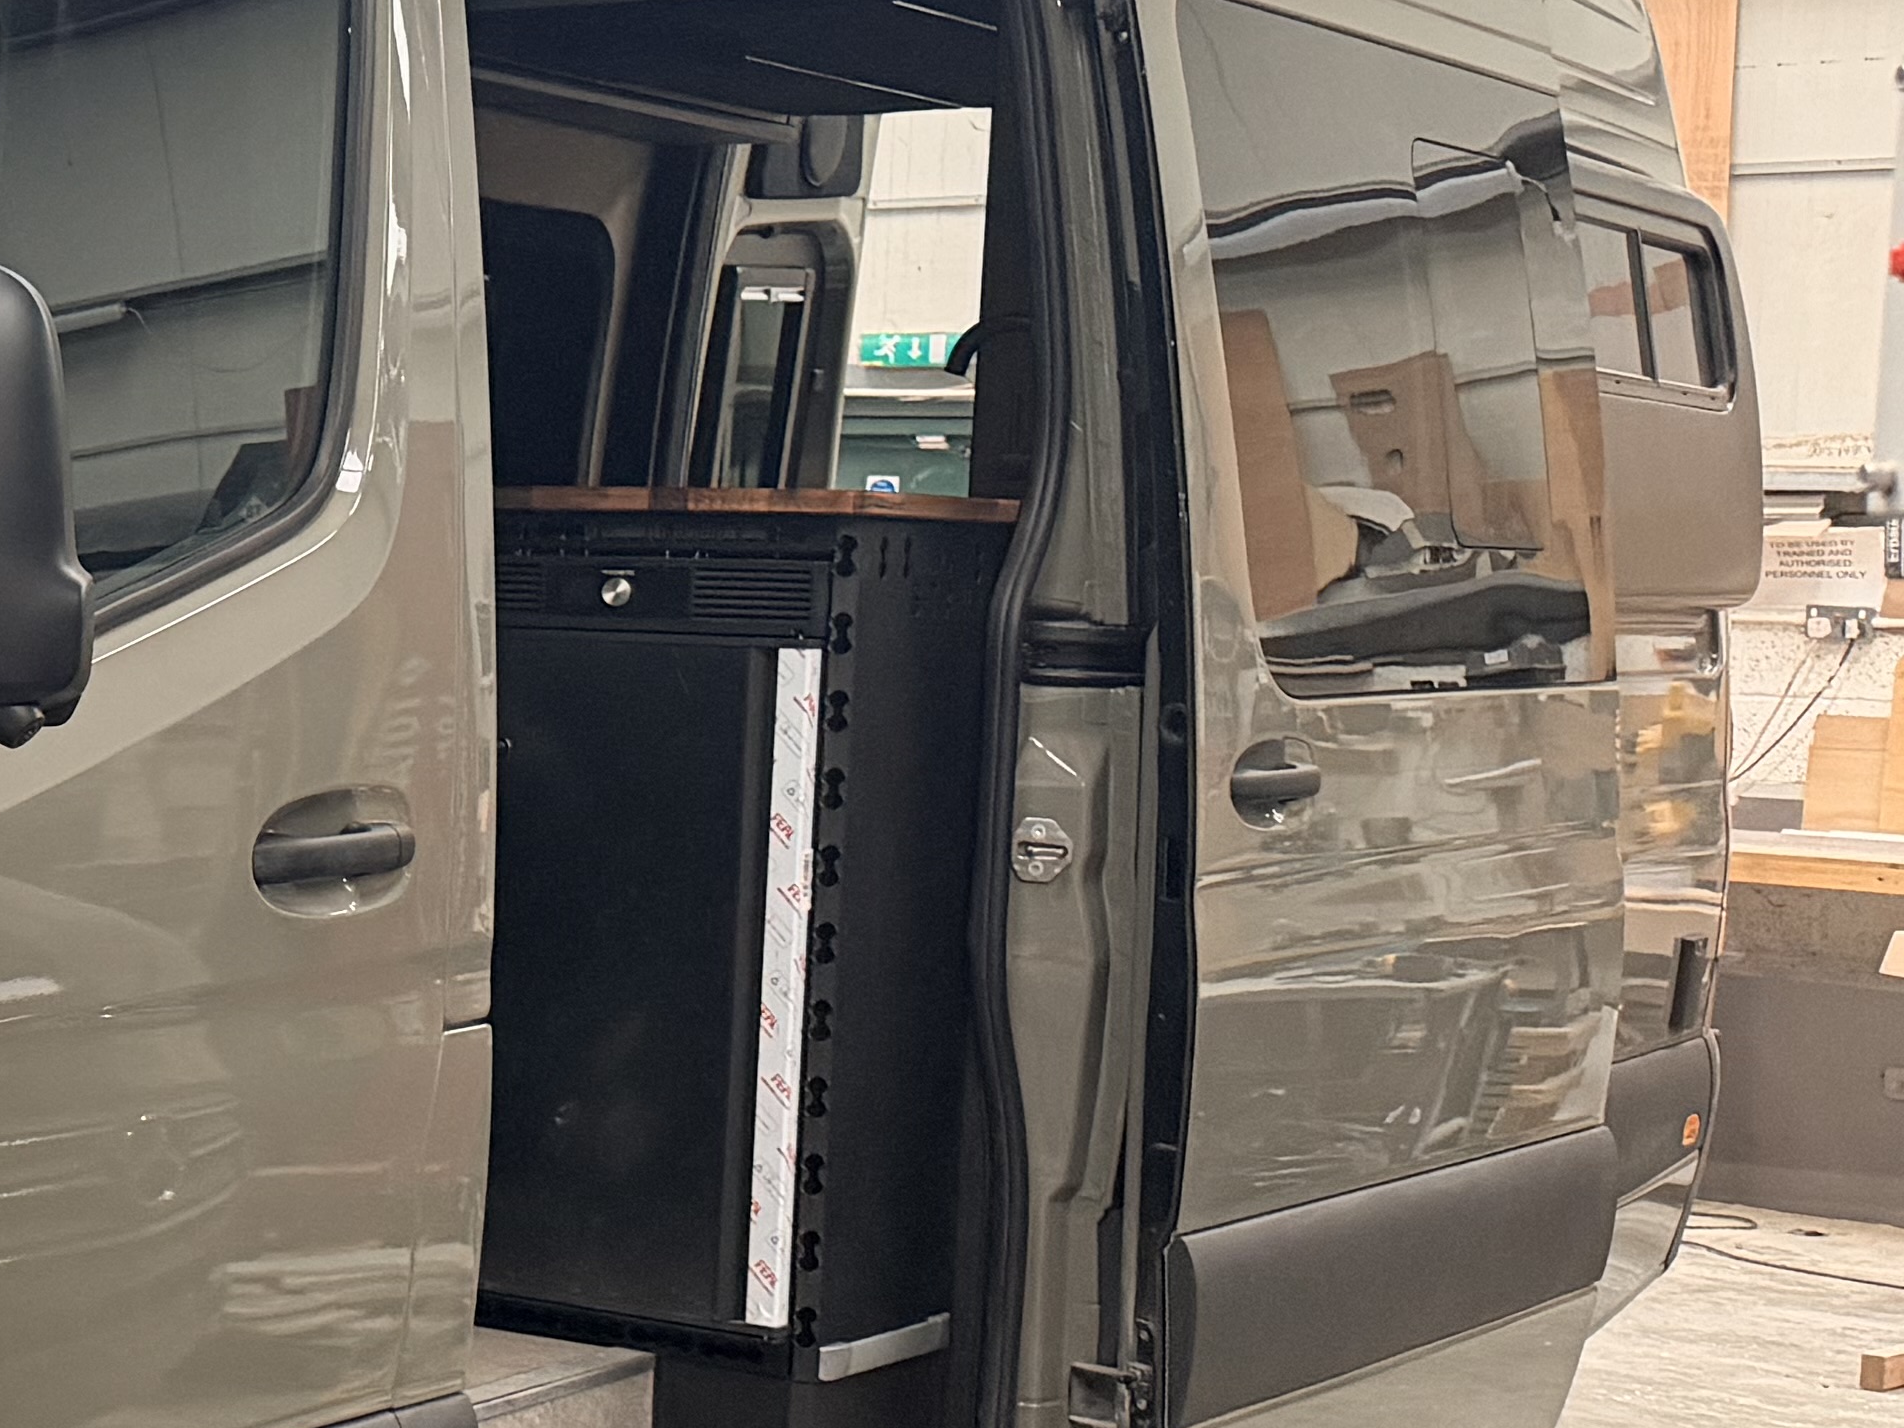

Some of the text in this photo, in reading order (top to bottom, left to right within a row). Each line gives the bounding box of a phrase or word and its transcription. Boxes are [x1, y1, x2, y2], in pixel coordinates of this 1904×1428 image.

[1776, 549, 1853, 558] TRAINED AND
[1779, 559, 1853, 567] AUTHORISED
[1765, 570, 1868, 580] PERSONNEL ONLY
